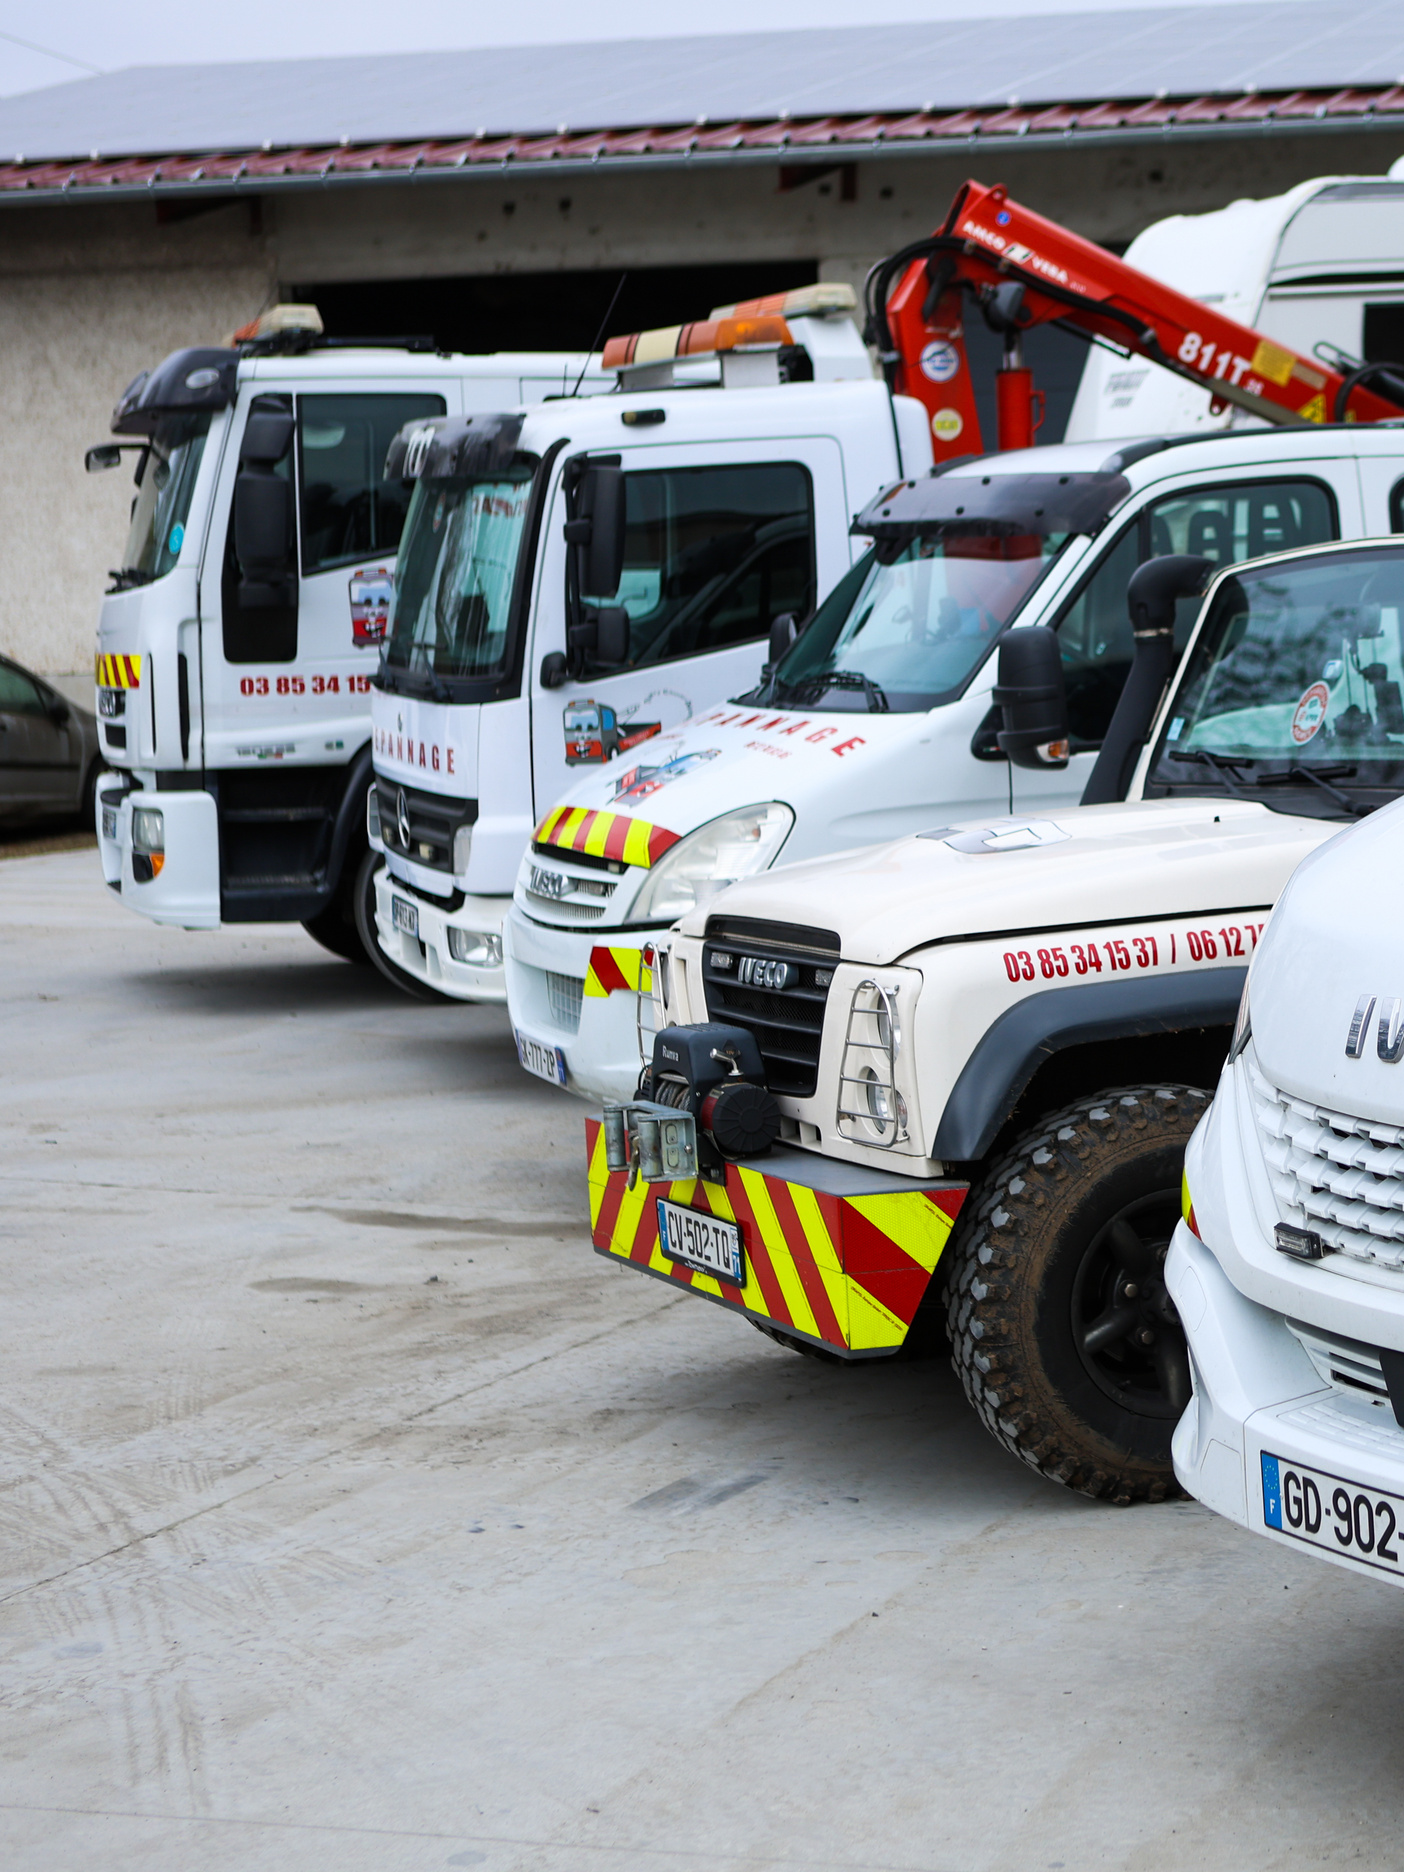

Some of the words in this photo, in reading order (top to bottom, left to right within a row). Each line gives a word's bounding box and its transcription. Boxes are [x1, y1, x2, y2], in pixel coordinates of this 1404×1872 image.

[962, 220, 1007, 250] AMCO
[1031, 255, 1069, 284] VEBA
[1177, 331, 1251, 386] 811T
[240, 675, 270, 697] 03
[276, 675, 306, 696] 85
[311, 674, 340, 695] 34
[345, 674, 371, 695] 15
[373, 724, 455, 775] EPANNAGE
[737, 956, 788, 989] IVECO
[1003, 951, 1035, 983] 03
[1037, 947, 1069, 979] 85
[1071, 943, 1102, 975] 34
[1103, 939, 1131, 970] 15
[1132, 936, 1158, 968] 37
[1170, 933, 1176, 964] /
[1186, 930, 1218, 962] 06
[1218, 926, 1245, 957] 12
[667, 1210, 731, 1270] CV-502-TQ
[1269, 1498, 1276, 1515] F
